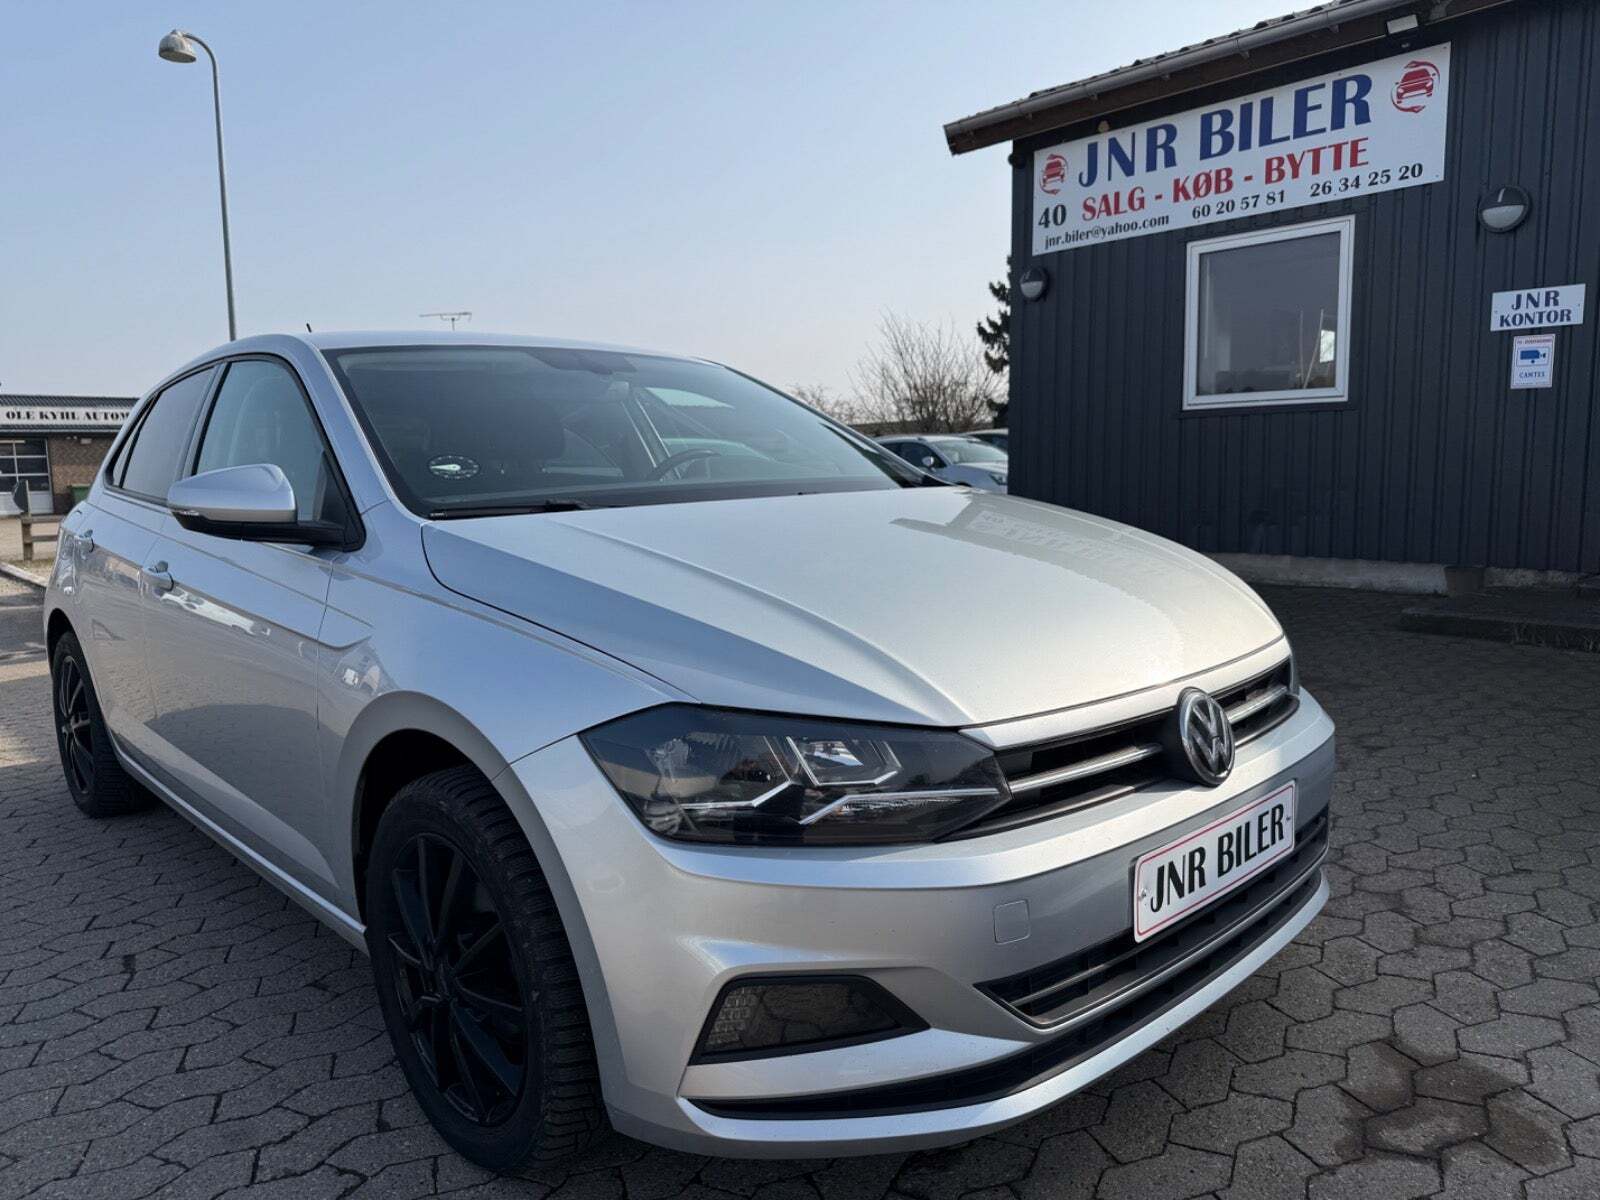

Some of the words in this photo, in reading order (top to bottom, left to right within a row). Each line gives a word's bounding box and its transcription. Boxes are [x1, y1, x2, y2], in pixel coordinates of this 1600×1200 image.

[1079, 124, 1178, 188] JNR
[1199, 74, 1372, 160] BILER
[1082, 186, 1145, 221] SALG
[1173, 167, 1233, 203] KØB
[1265, 137, 1369, 184] BYTTE
[1310, 180, 1332, 197] 26
[1338, 175, 1361, 192] 34
[1368, 169, 1391, 187] 25
[1399, 163, 1423, 181] 20
[1038, 204, 1067, 228] 40
[1192, 204, 1211, 219] 60
[1216, 199, 1235, 215] 20
[1240, 194, 1260, 210] 57
[1266, 190, 1285, 206] 81
[1044, 214, 1169, 249] jnr.biler@yahoo.com
[1511, 290, 1560, 310] JNR
[1499, 309, 1572, 327] KONTOR
[5, 410, 35, 420] OLE
[1150, 846, 1206, 913] JNR
[1217, 803, 1284, 878] BILER
